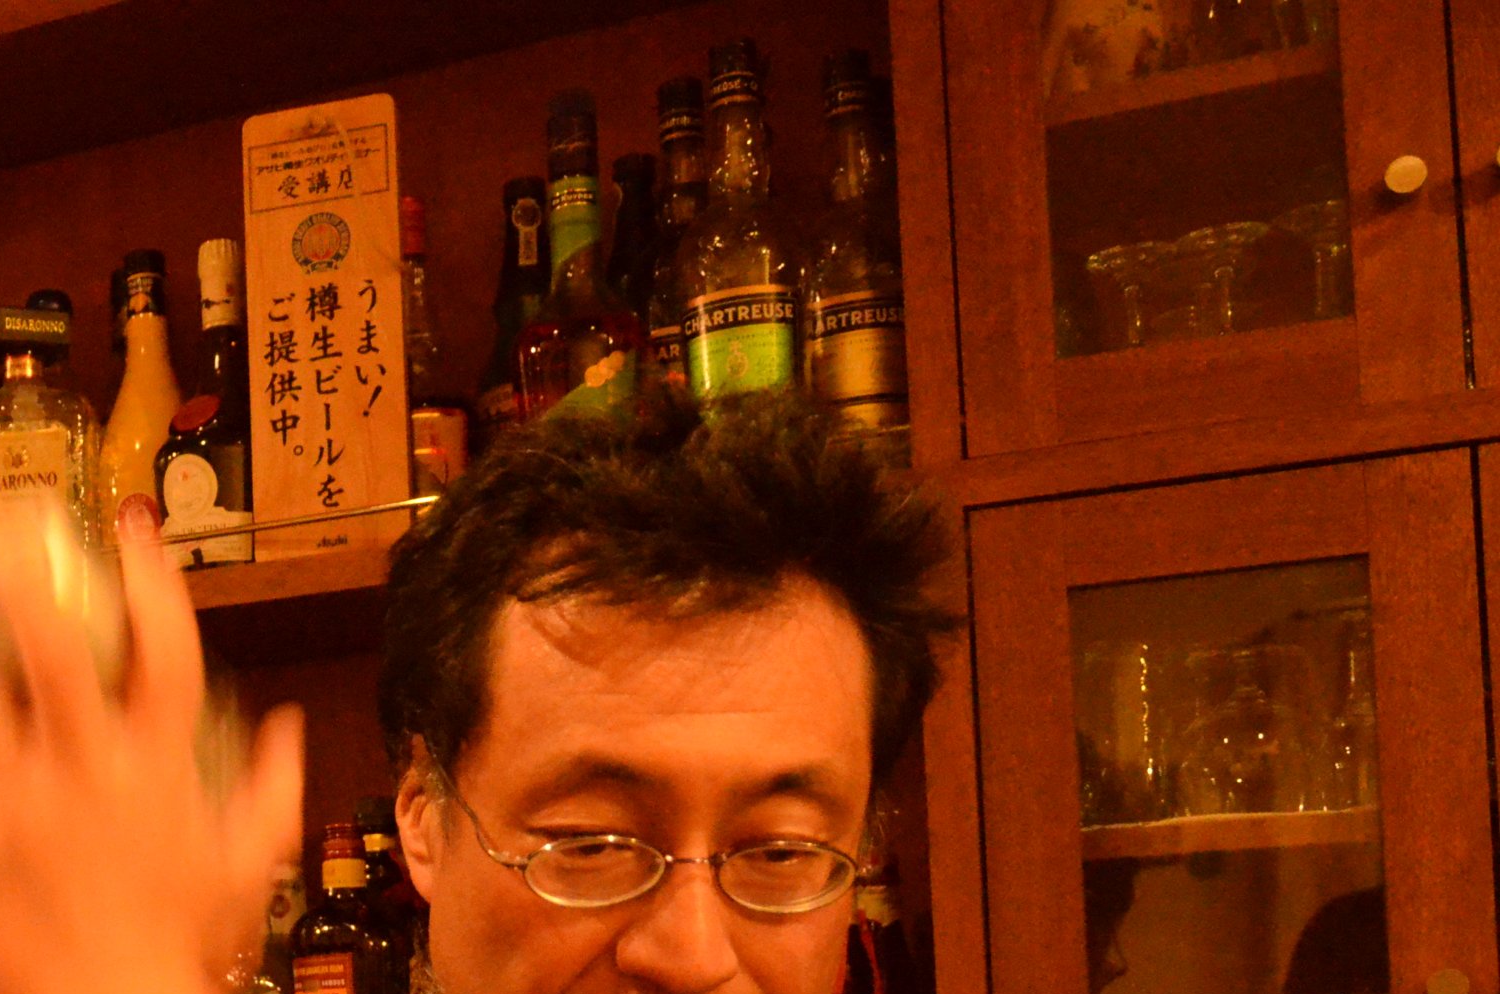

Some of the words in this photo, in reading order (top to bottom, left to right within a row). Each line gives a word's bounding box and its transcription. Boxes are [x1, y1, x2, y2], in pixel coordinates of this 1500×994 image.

[4, 316, 67, 334] DISARONNO
[685, 302, 794, 335] CHARTREUSE
[814, 306, 902, 336] ARTREUS
[264, 292, 303, 456] ご提供中。
[305, 283, 346, 508] 樽生ビールを
